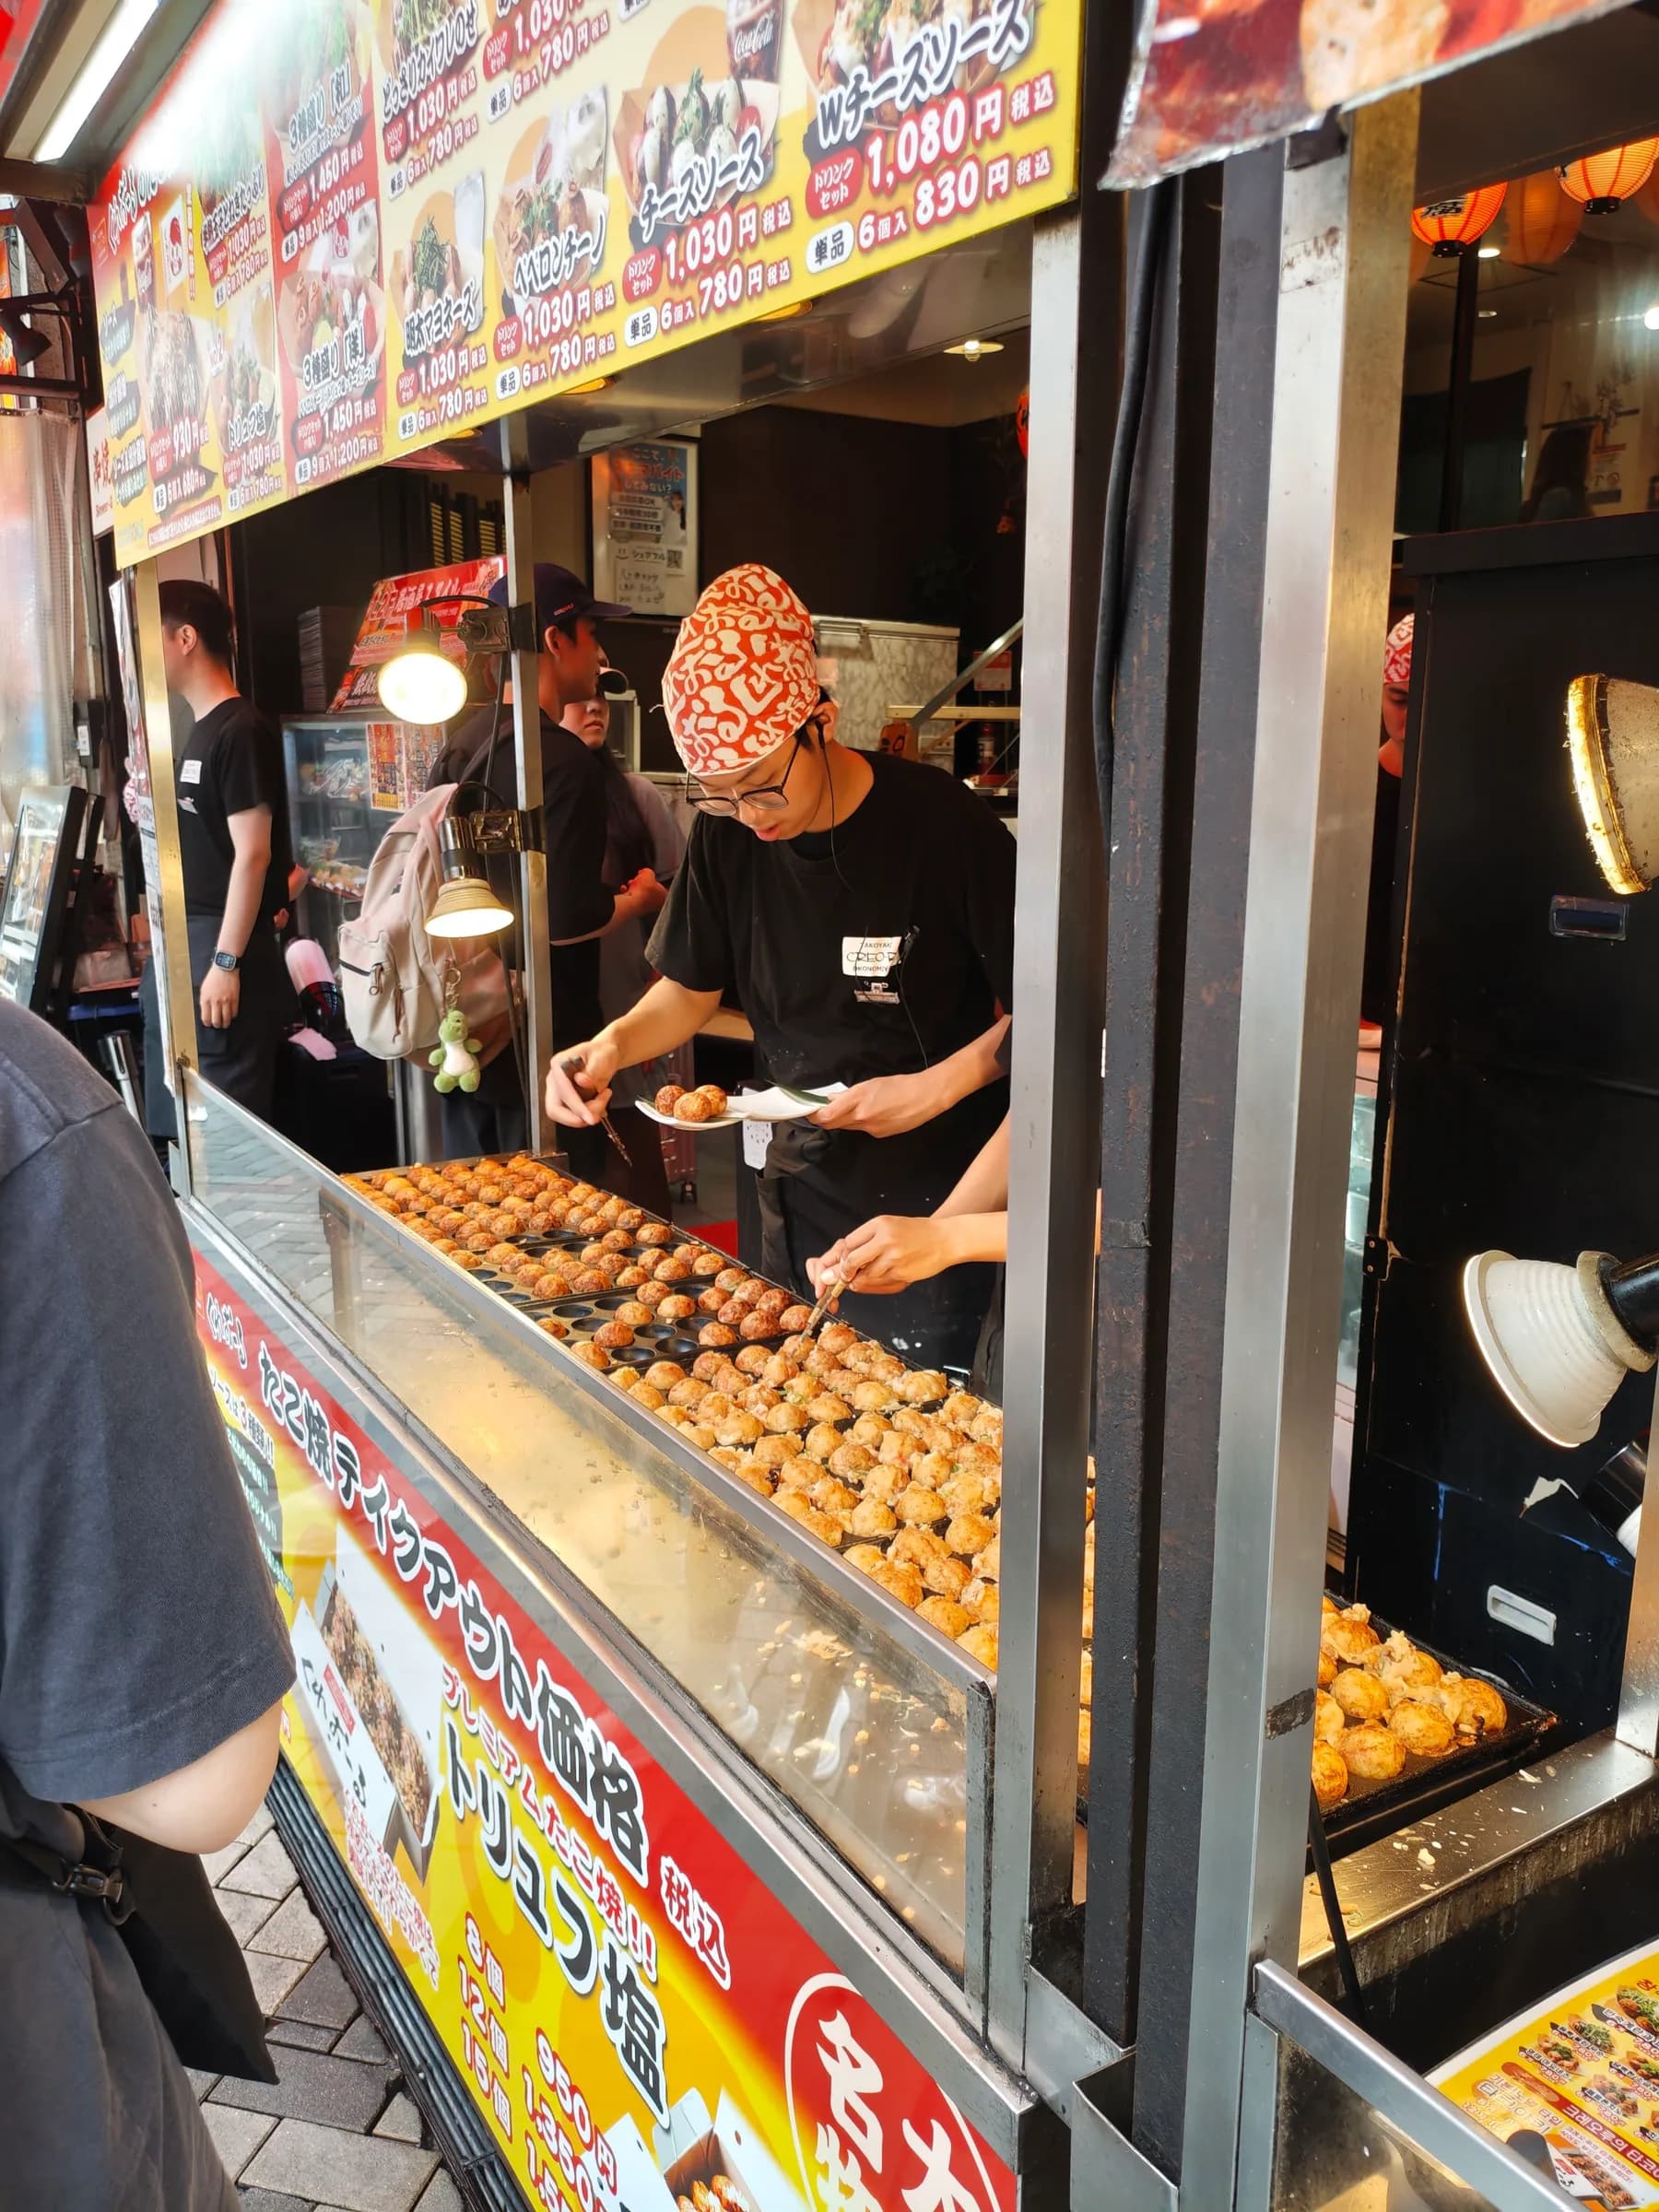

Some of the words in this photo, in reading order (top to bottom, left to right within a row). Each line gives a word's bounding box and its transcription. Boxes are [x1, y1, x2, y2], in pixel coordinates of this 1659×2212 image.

[541, 23, 589, 82] 780円
[818, 0, 1029, 148] Wチーズソース
[639, 126, 764, 243] チーズソース
[815, 157, 855, 194] ドリンク
[819, 185, 850, 211] セット
[514, 208, 609, 300] ペペロンチーノ
[628, 254, 655, 282] ドリンク
[815, 230, 844, 265] 単品
[857, 211, 908, 250] 6個入
[405, 278, 476, 357] 明太マヨネーズ
[630, 314, 651, 341] 単品
[660, 300, 694, 330] 6個入
[631, 276, 653, 297] セット
[500, 371, 516, 394] 単品
[442, 1663, 657, 1983] プレミアムたこ焼!!
[443, 1712, 671, 2130] トリュフ塩
[465, 1912, 506, 2013] 8個
[661, 1855, 731, 1990] 税込
[458, 1954, 510, 2079] 12個
[461, 2016, 512, 2143] 15個
[536, 2028, 618, 2195] 950円
[523, 2065, 608, 2212] 1,350
